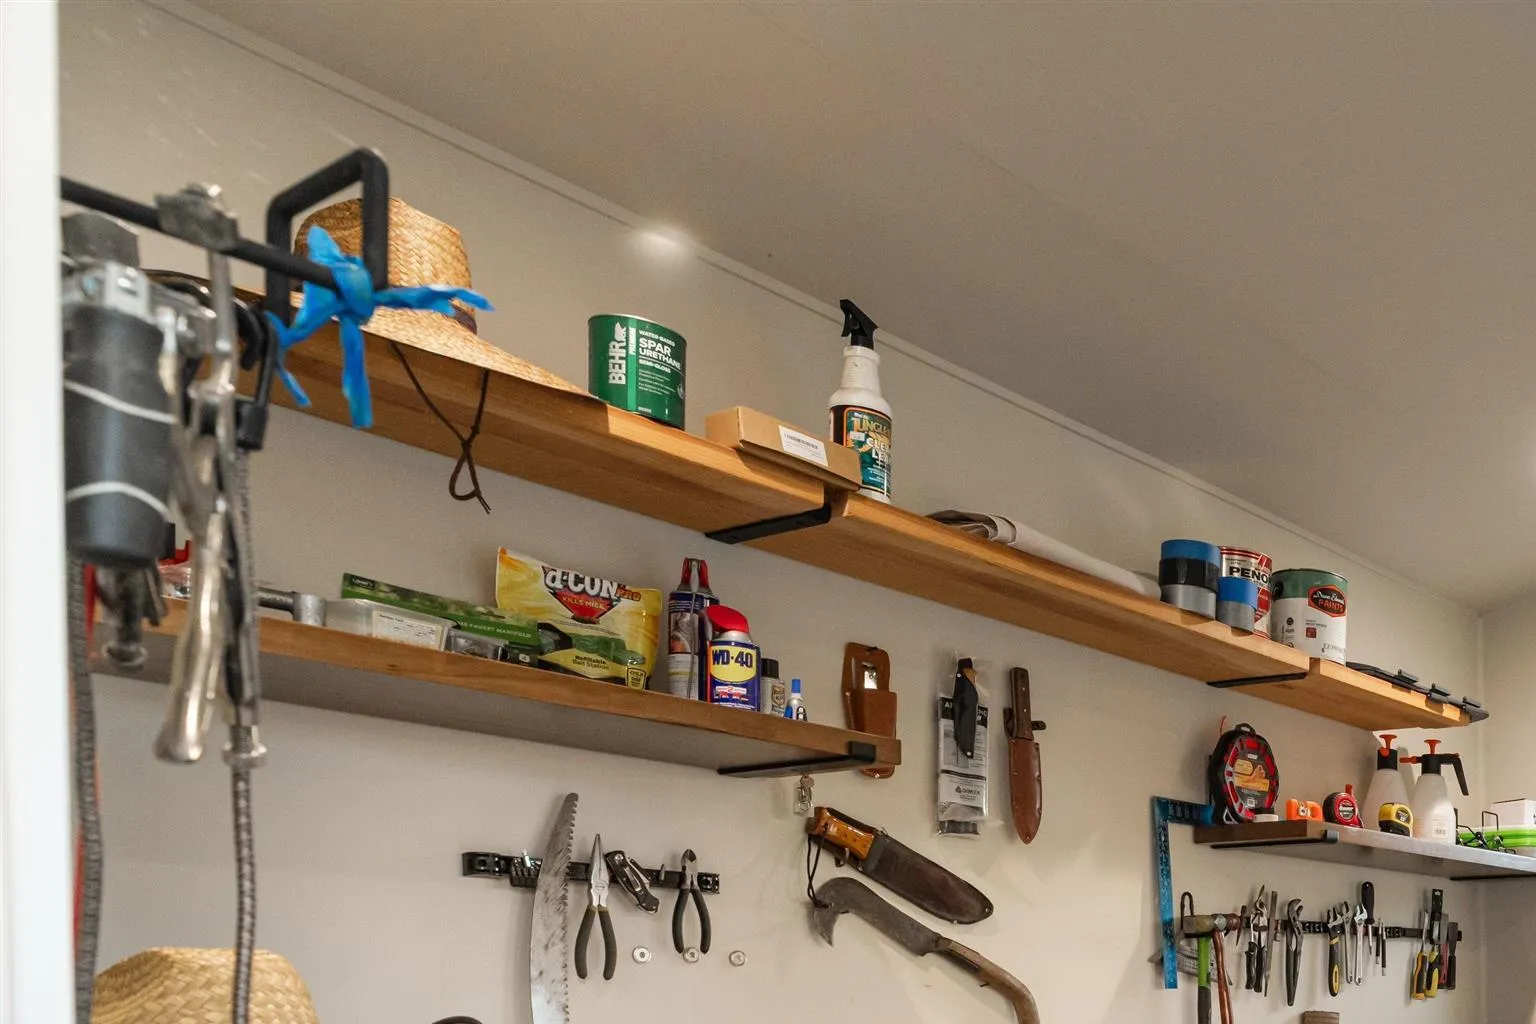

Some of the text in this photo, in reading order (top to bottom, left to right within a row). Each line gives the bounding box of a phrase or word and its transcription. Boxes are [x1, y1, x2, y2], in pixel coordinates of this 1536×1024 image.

[639, 338, 671, 356] SPAR
[608, 336, 626, 385] BEHR
[639, 348, 681, 370] URETHANE
[562, 595, 585, 607] KILLS
[1318, 599, 1344, 613] PAINTS
[712, 649, 754, 669] WD-40
